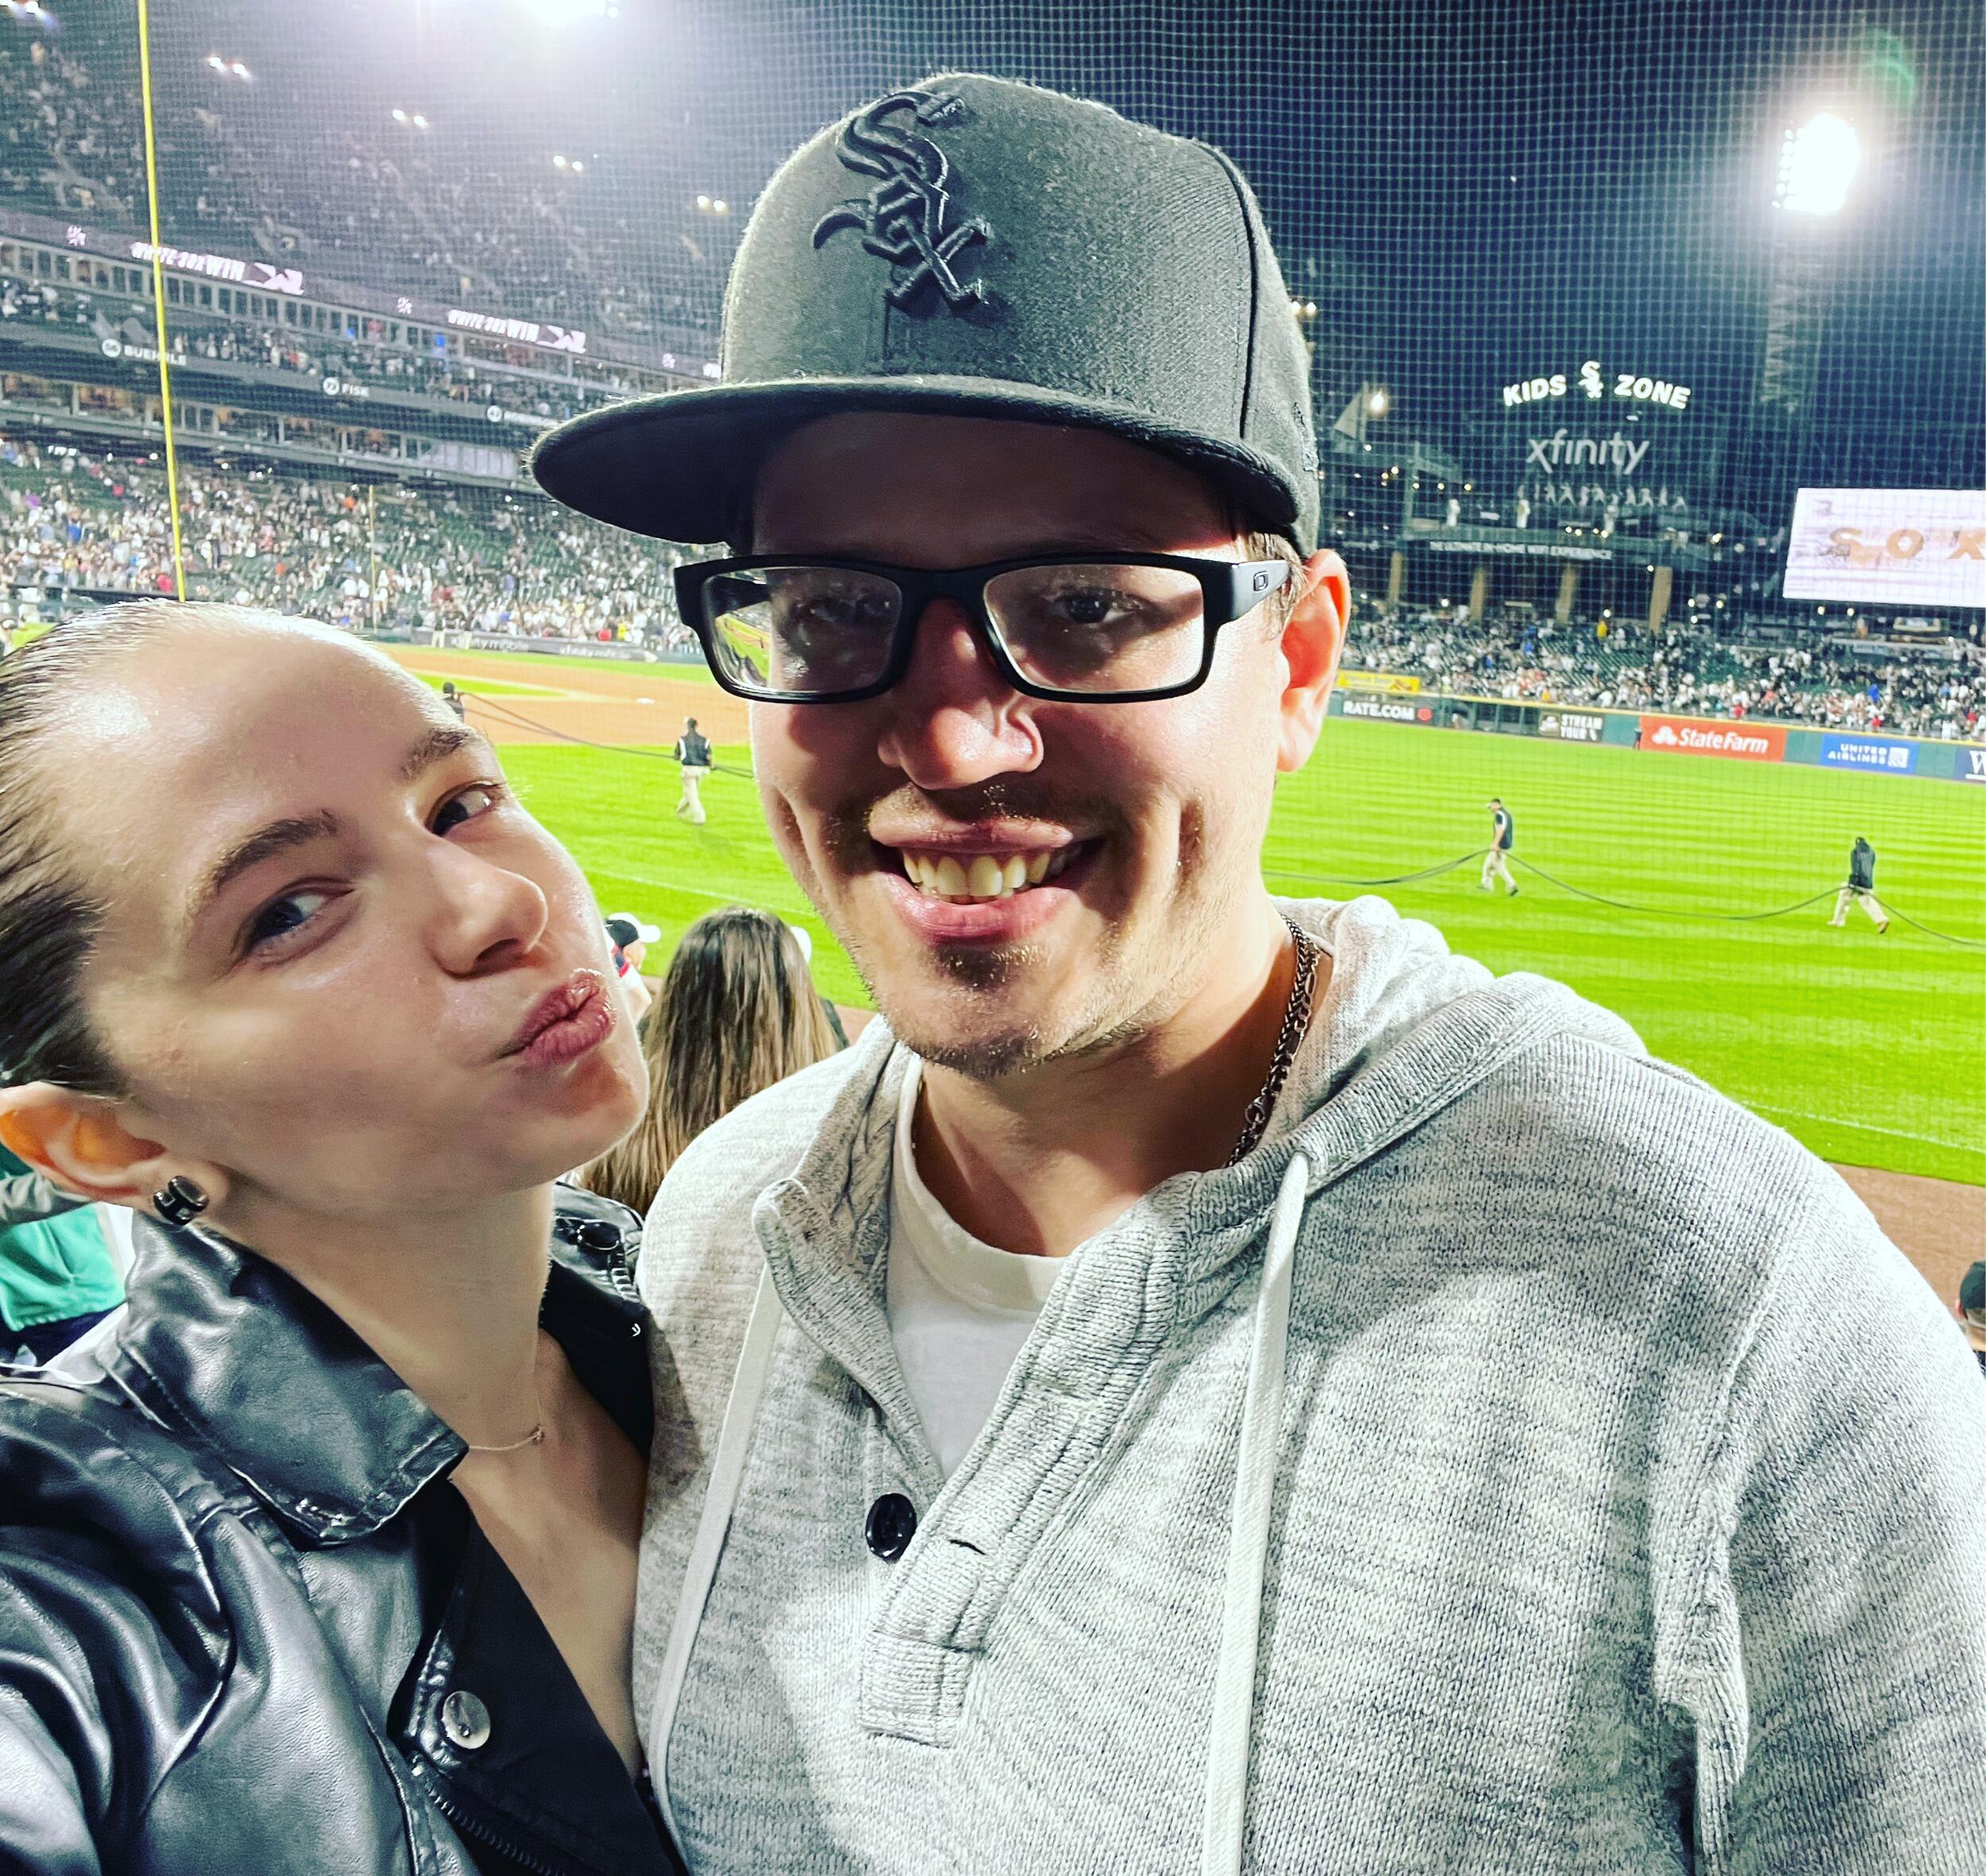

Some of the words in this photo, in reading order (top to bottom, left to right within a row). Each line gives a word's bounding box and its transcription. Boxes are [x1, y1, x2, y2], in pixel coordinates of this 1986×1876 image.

[206, 254, 245, 281] WIN
[507, 319, 540, 342] WIN
[1503, 374, 1567, 407] KIDS
[1613, 374, 1691, 409] ZONE
[1526, 428, 1650, 474] xfinity
[1343, 700, 1415, 721] RATE.COM
[1560, 725, 1587, 740] YOUR
[1561, 714, 1603, 730] STREAM
[1827, 750, 1886, 765] AIRLINES
[1840, 743, 1887, 756] UNITED
